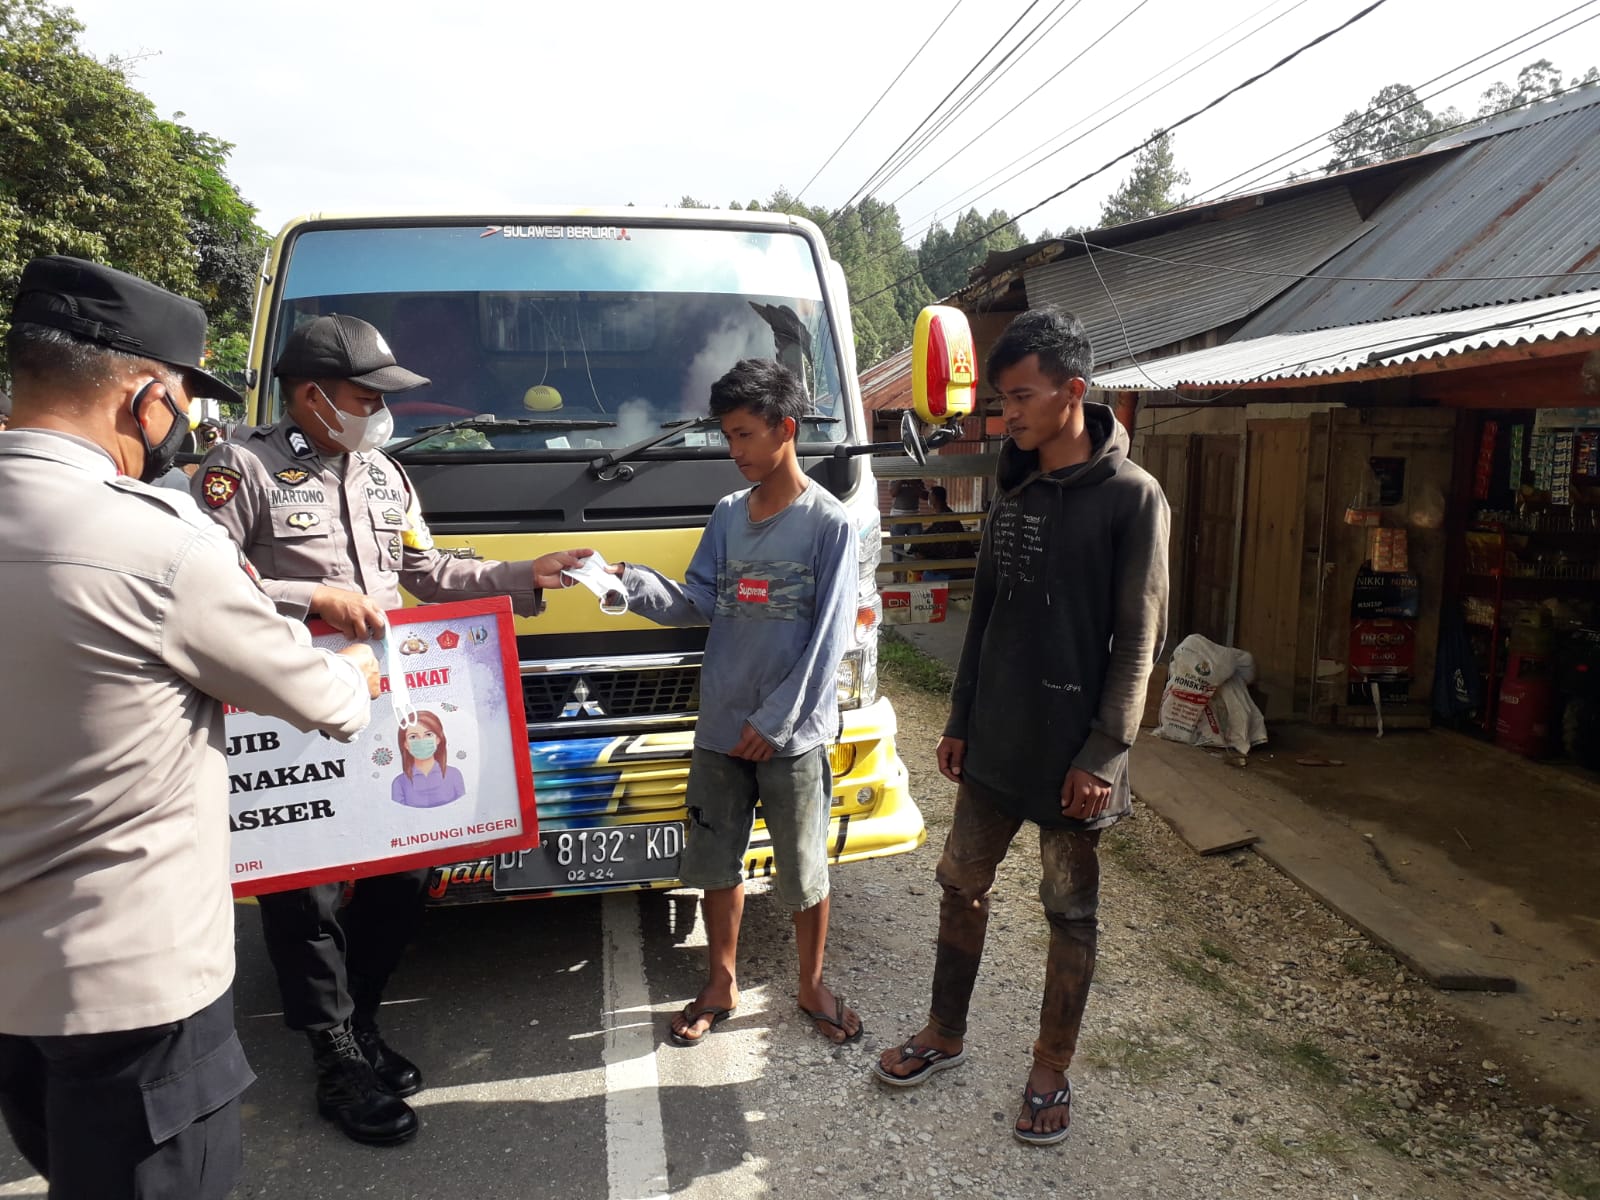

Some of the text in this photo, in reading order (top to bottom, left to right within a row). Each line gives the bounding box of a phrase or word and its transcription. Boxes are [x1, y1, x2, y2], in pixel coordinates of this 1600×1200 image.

[503, 225, 617, 240] SULAWESI BERLIAN
[271, 490, 325, 506] MARTONO
[367, 487, 402, 502] POLRI
[1357, 576, 1385, 586] NIKKI
[738, 582, 767, 598] Supreme
[390, 818, 518, 849] #LINDUNGI NEGERI
[557, 831, 625, 866] 8132
[646, 826, 679, 860] KD
[235, 859, 263, 874] DIRI
